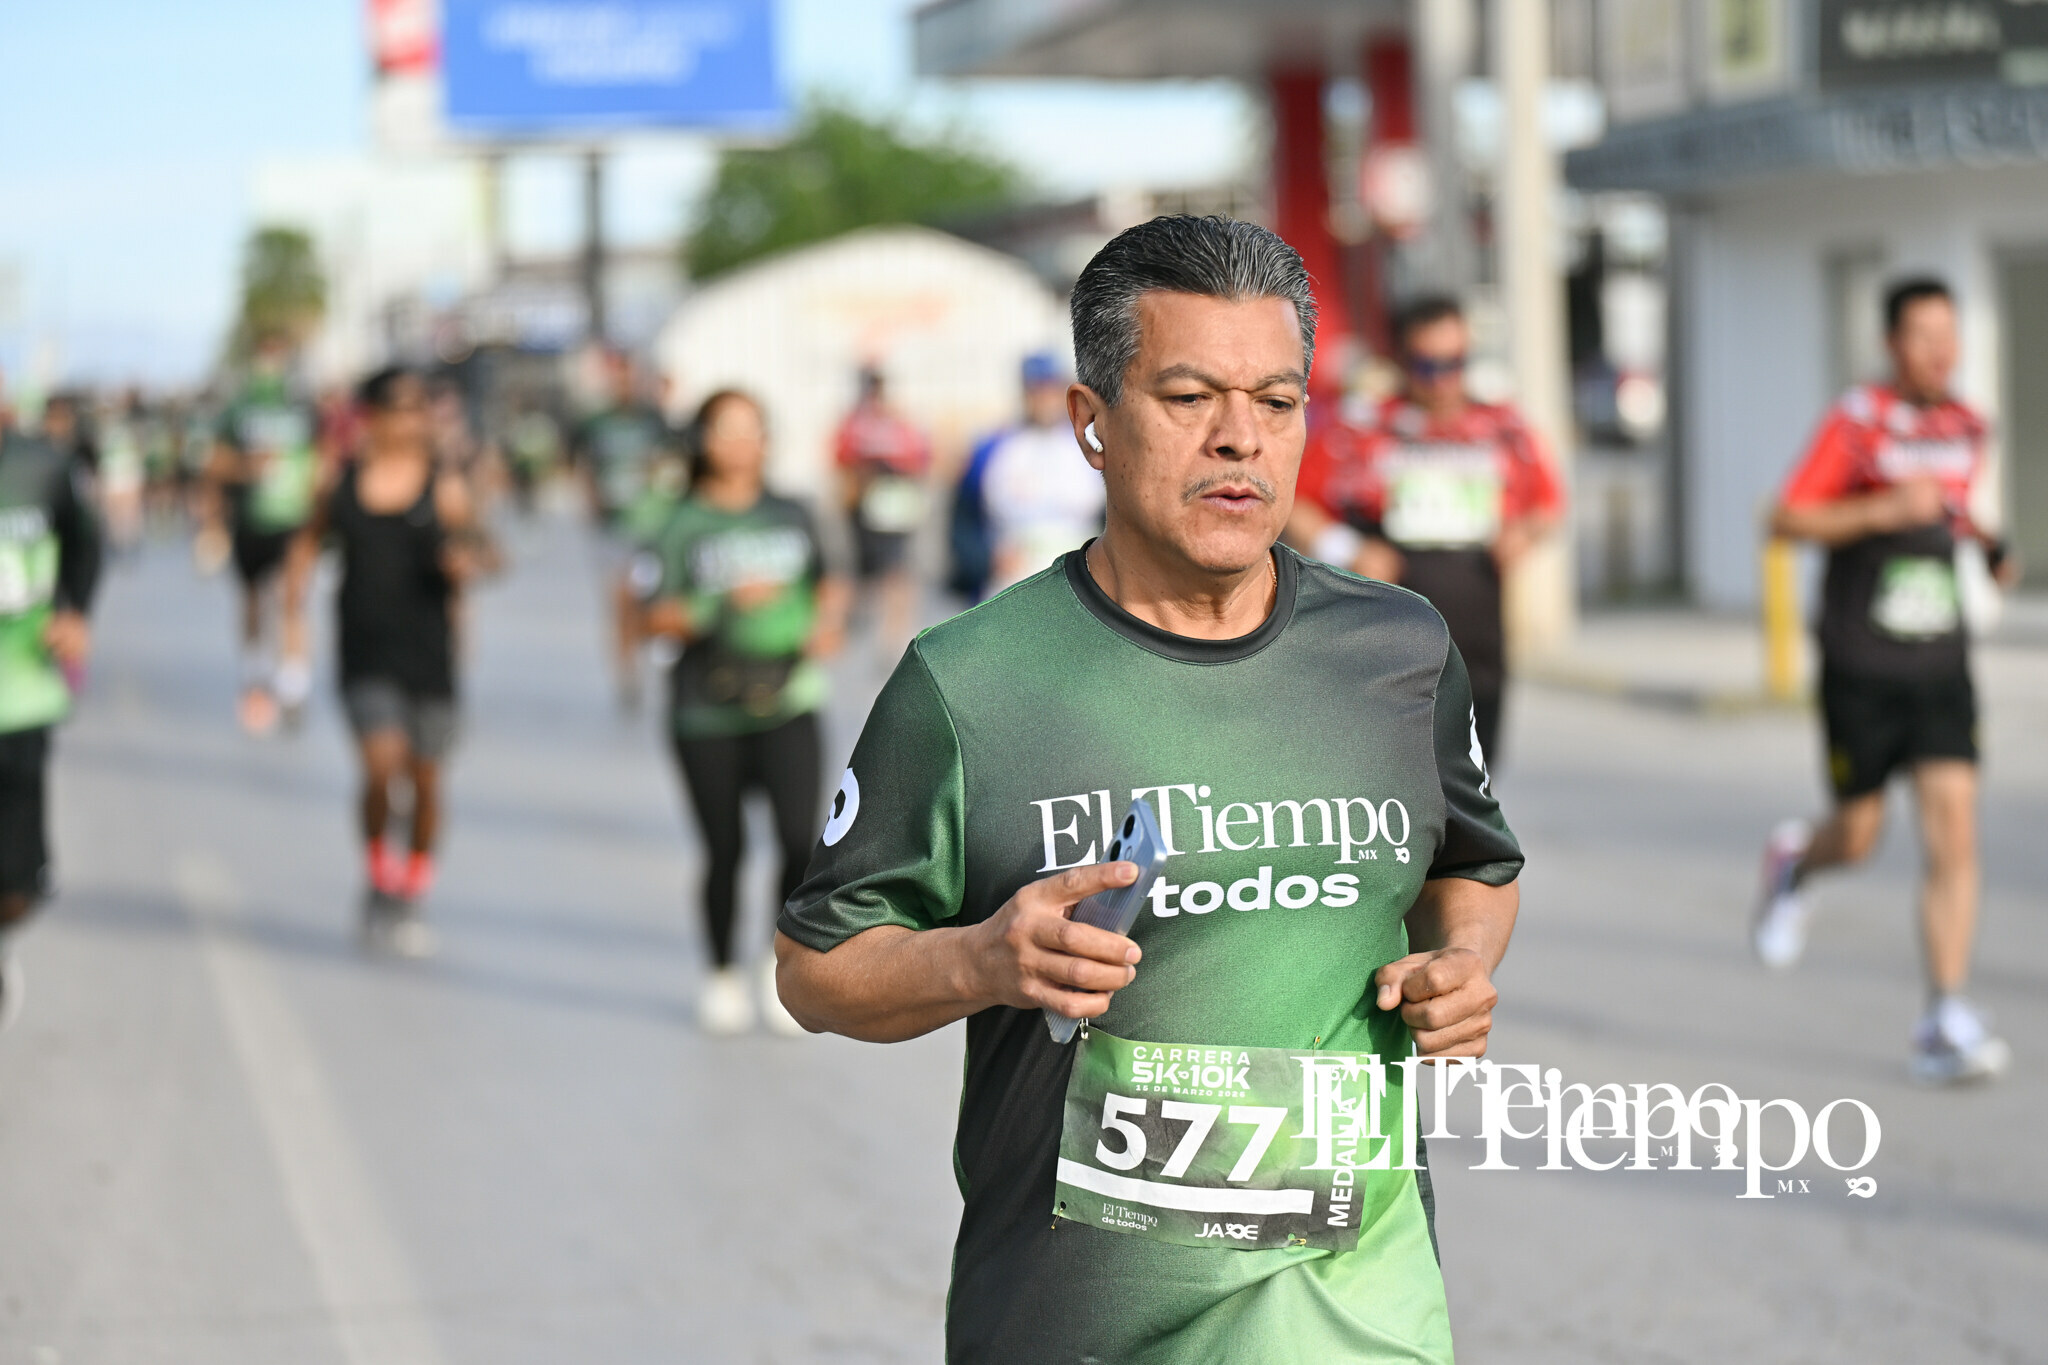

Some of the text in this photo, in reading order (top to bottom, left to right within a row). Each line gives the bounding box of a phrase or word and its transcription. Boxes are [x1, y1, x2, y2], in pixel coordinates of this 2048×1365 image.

[1030, 783, 1410, 872] El Tiempo MX
[1147, 866, 1360, 918] todos
[1133, 1046, 1251, 1065] CARRERA
[1153, 1085, 1168, 1093] DE
[1173, 1087, 1213, 1096] MARZO
[1095, 1092, 1288, 1182] 577
[1101, 1216, 1147, 1231] de todos
[1103, 1202, 1158, 1227] El Tiempo
